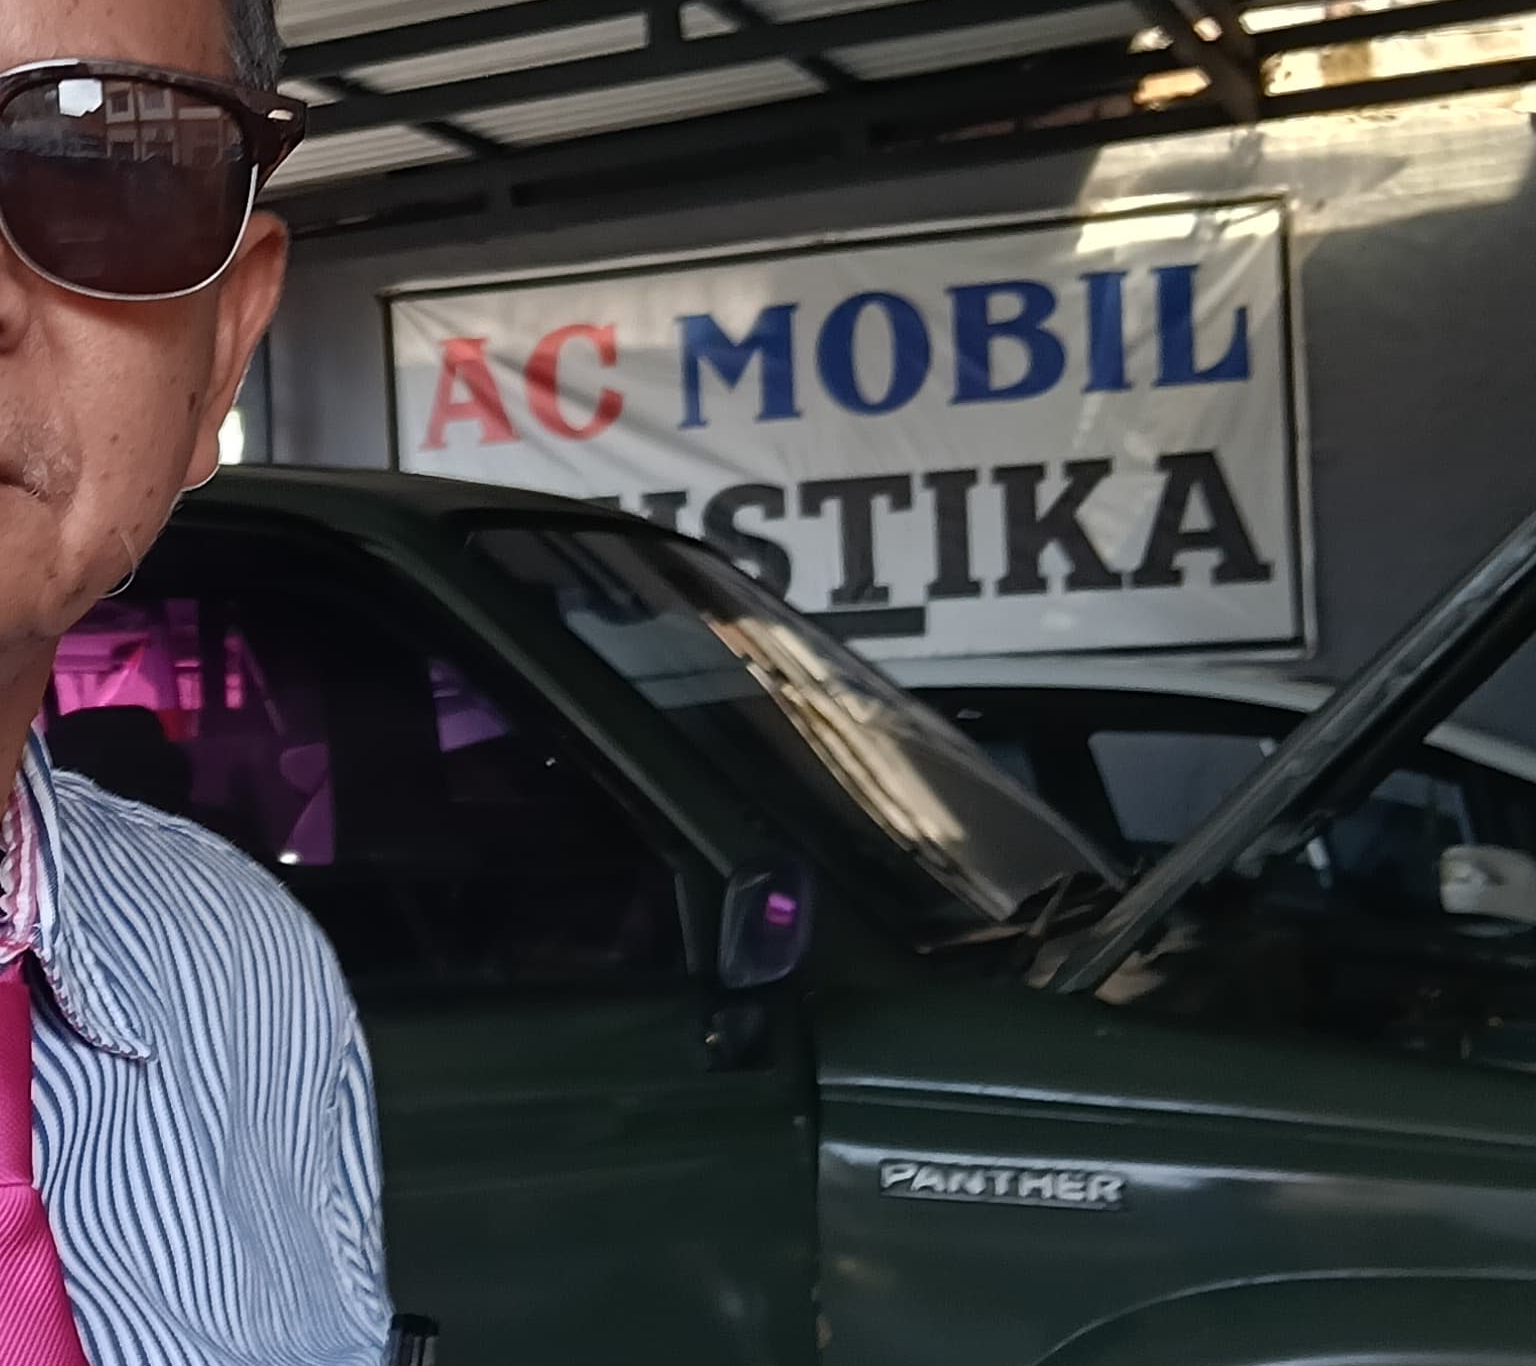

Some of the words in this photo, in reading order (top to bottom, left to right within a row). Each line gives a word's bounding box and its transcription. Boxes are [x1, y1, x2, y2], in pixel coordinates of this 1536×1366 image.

[420, 322, 624, 450] AC
[675, 264, 1252, 431] MOBIL
[582, 451, 1274, 607] STIKA
[880, 1161, 1125, 1203] PANTHER
